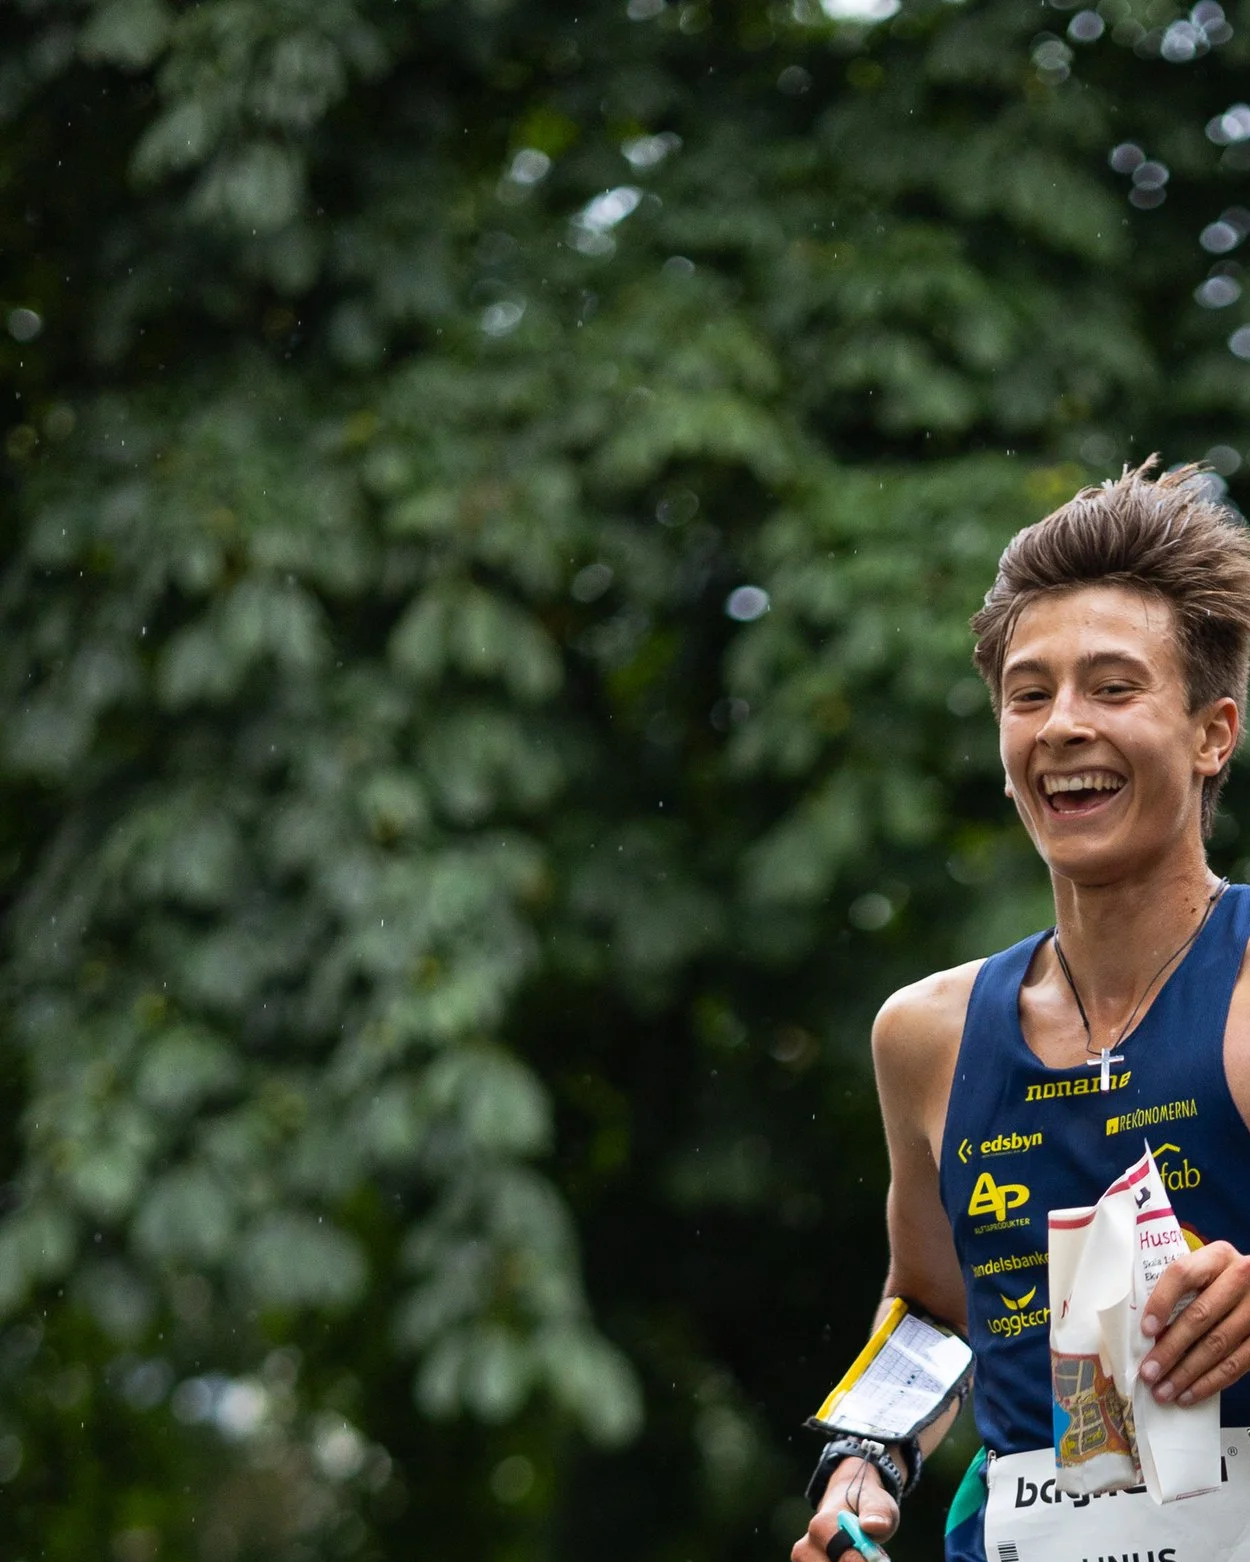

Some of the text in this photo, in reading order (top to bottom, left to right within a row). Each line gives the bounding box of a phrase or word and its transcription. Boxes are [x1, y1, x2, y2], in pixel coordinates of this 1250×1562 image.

[1025, 1071, 1132, 1102] noname
[1120, 1098, 1198, 1132] REKONOMERNA
[981, 1132, 1043, 1153] edsbyn
[1160, 1158, 1201, 1191] fab
[968, 1171, 1031, 1222] AP
